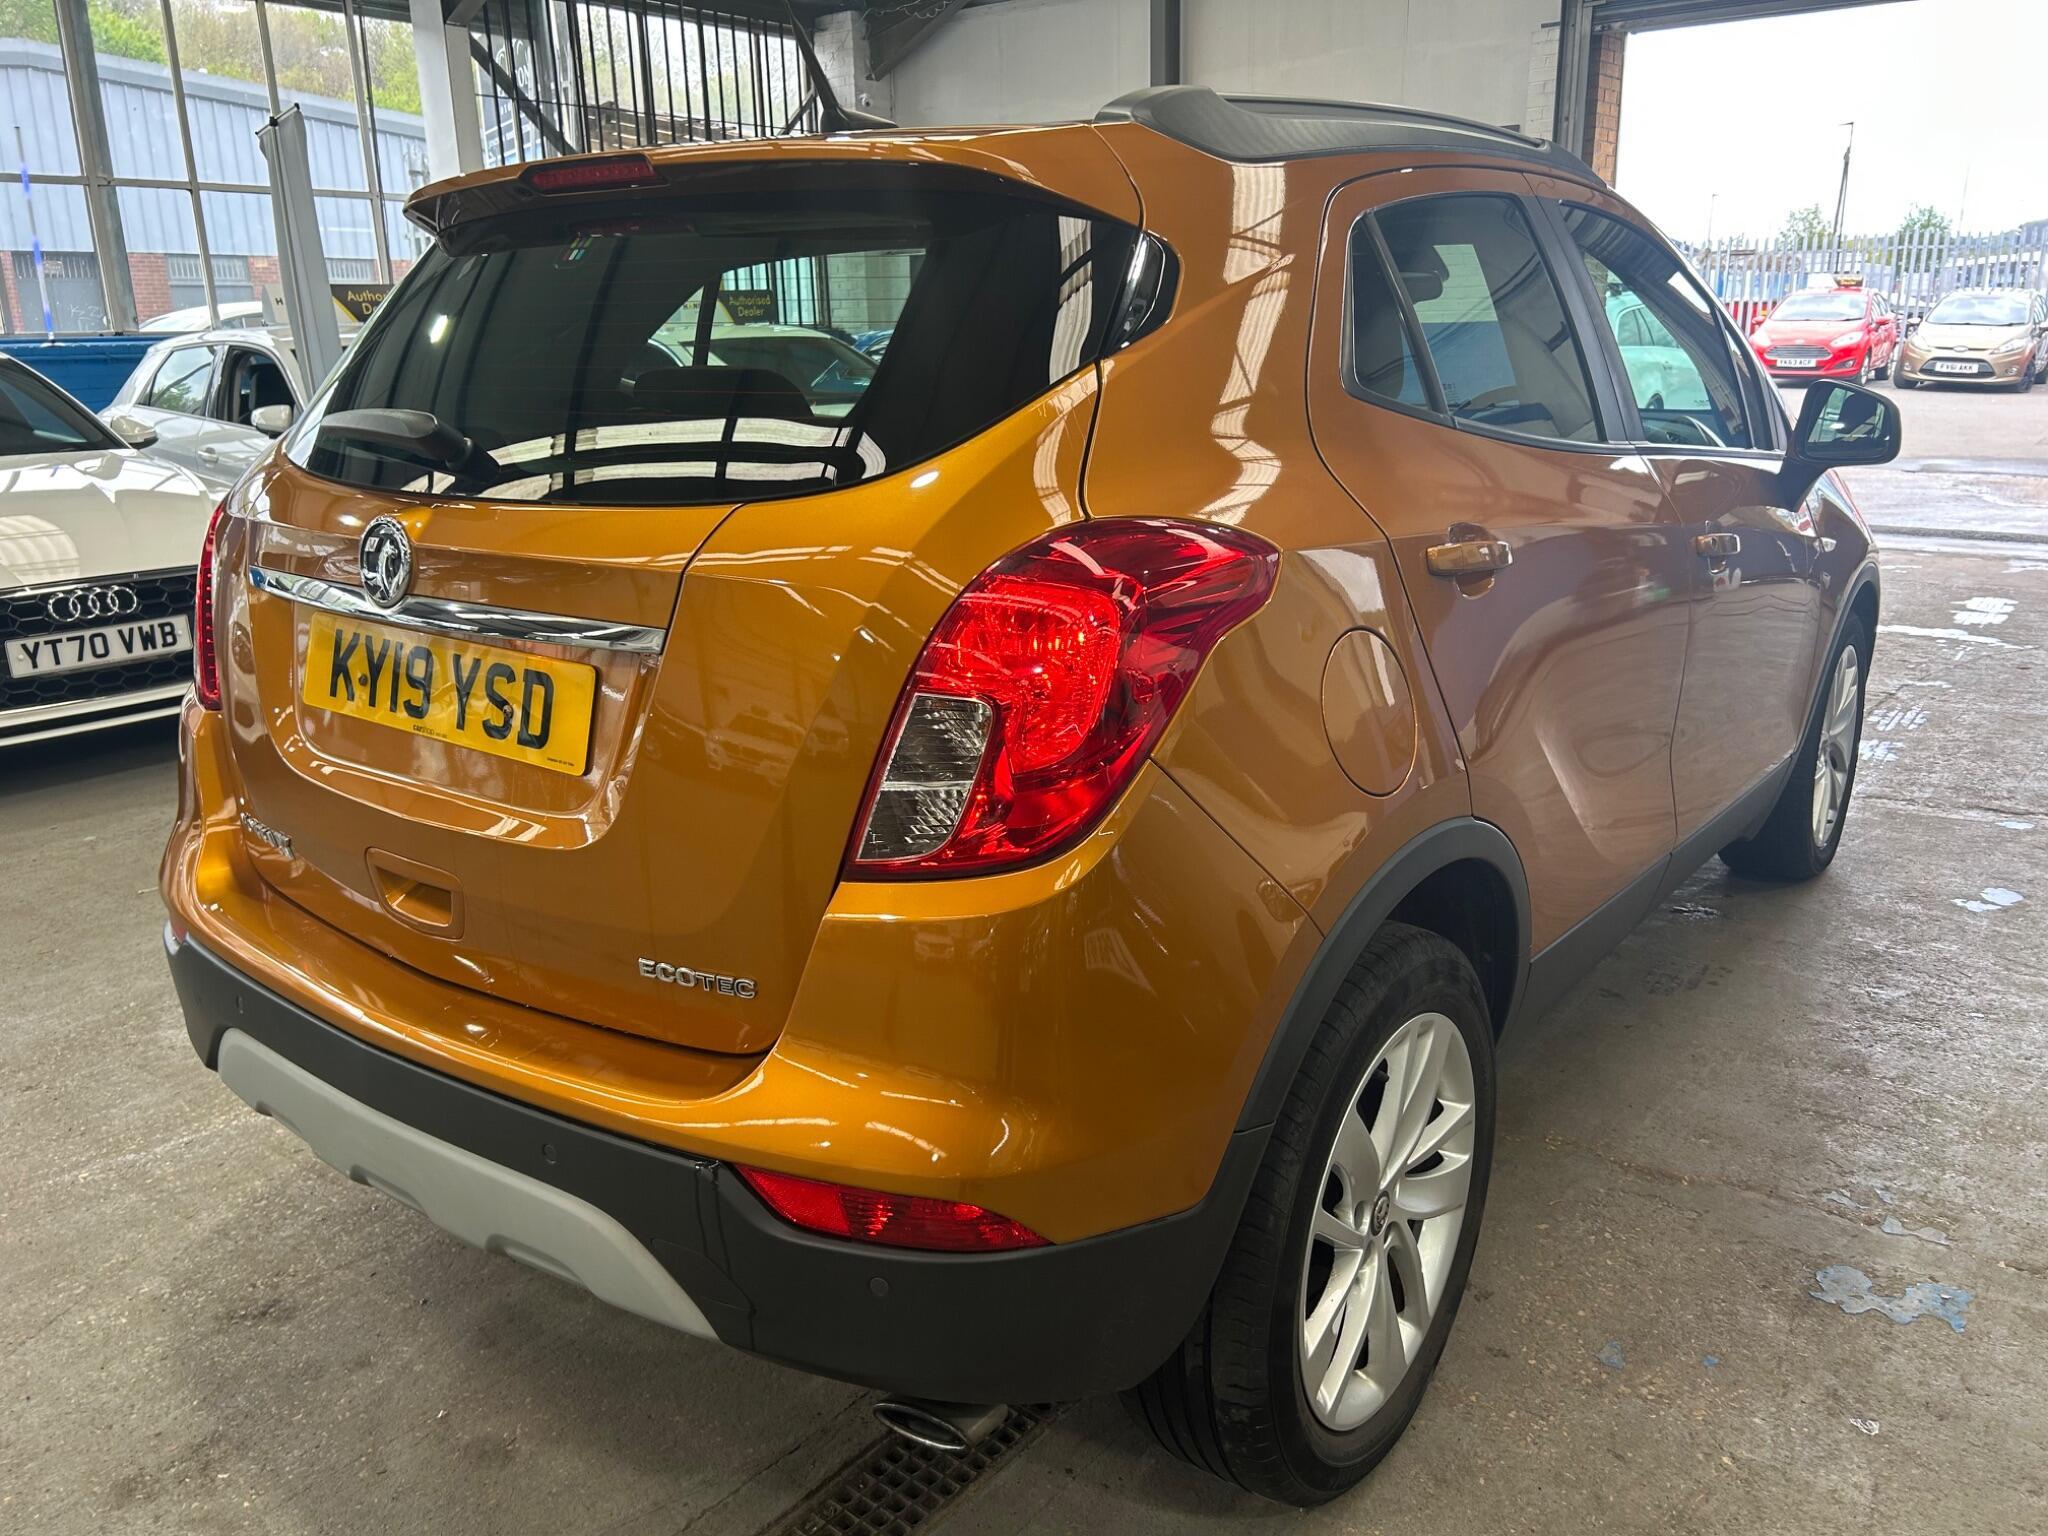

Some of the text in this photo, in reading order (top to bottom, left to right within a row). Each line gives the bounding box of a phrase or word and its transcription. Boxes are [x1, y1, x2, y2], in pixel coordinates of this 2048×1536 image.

[729, 294, 770, 305] Authorised
[737, 306, 764, 317] Dealer
[21, 621, 178, 669] YT70 VWB
[329, 628, 554, 750] KY19 YSD
[638, 957, 756, 999] ECOTEC
